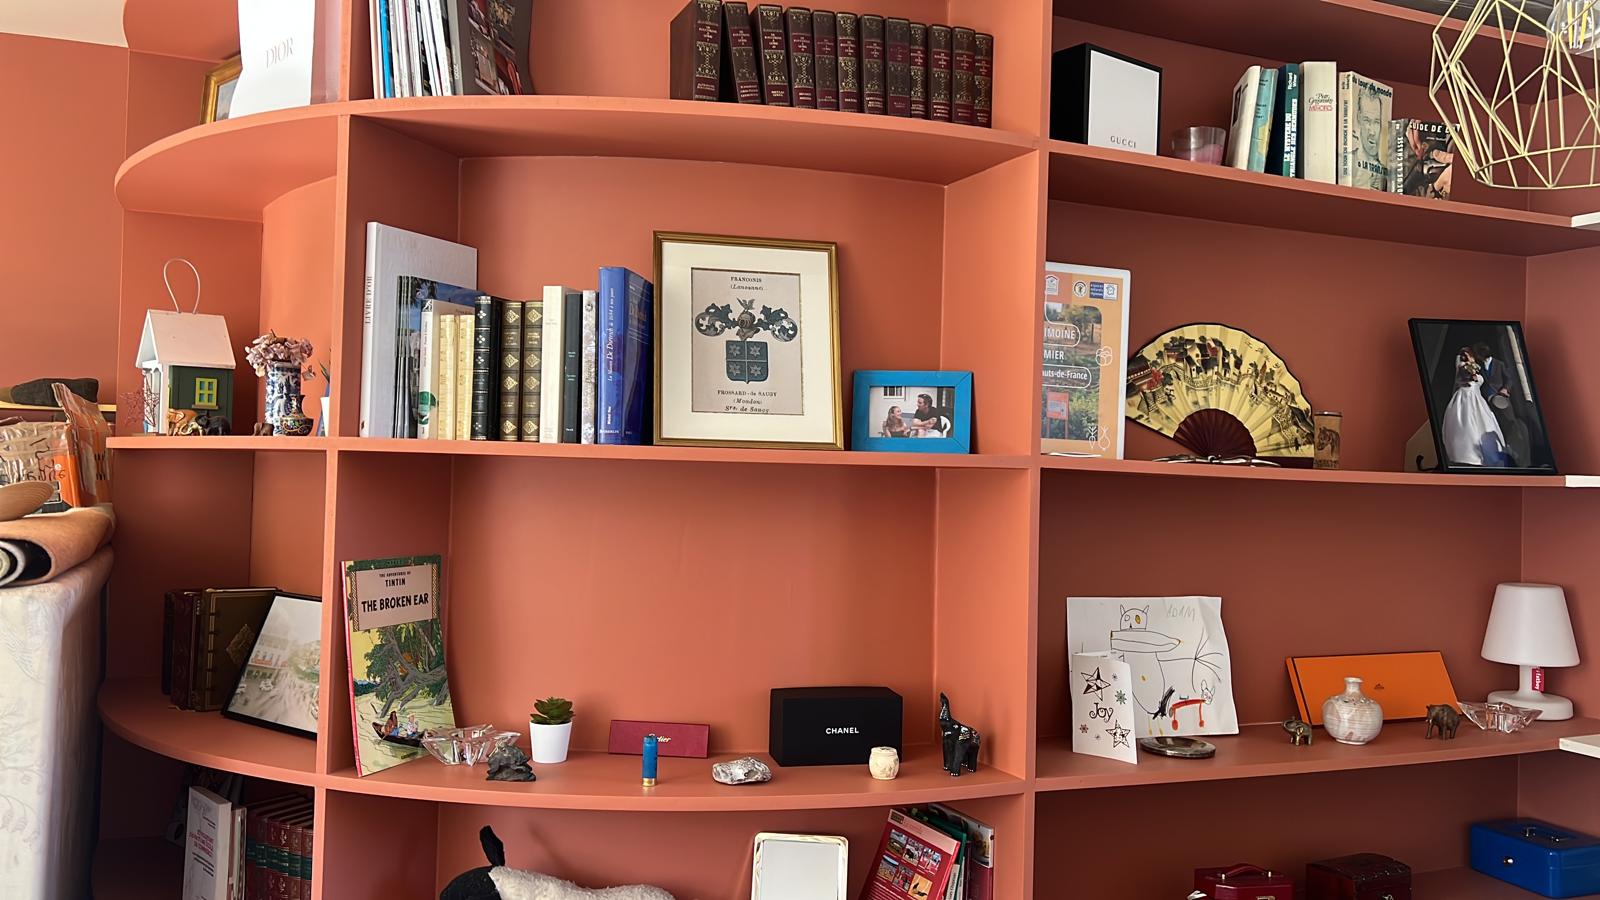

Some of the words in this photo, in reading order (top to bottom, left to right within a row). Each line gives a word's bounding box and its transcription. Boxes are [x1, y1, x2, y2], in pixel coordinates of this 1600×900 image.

[265, 37, 294, 69] DIOR
[1431, 124, 1443, 133] DE
[1110, 135, 1137, 148] GUCCI
[1397, 162, 1403, 172] LA
[1397, 173, 1403, 182] DE
[606, 328, 614, 350] Dietrich
[606, 351, 614, 360] De
[1043, 349, 1065, 361] MIER
[385, 577, 406, 587] TINTIN
[361, 600, 378, 614] THE
[379, 594, 412, 611] BROKEN
[414, 593, 429, 606] EAR
[1088, 702, 1114, 723] Joy
[825, 726, 860, 735] CHANEL
